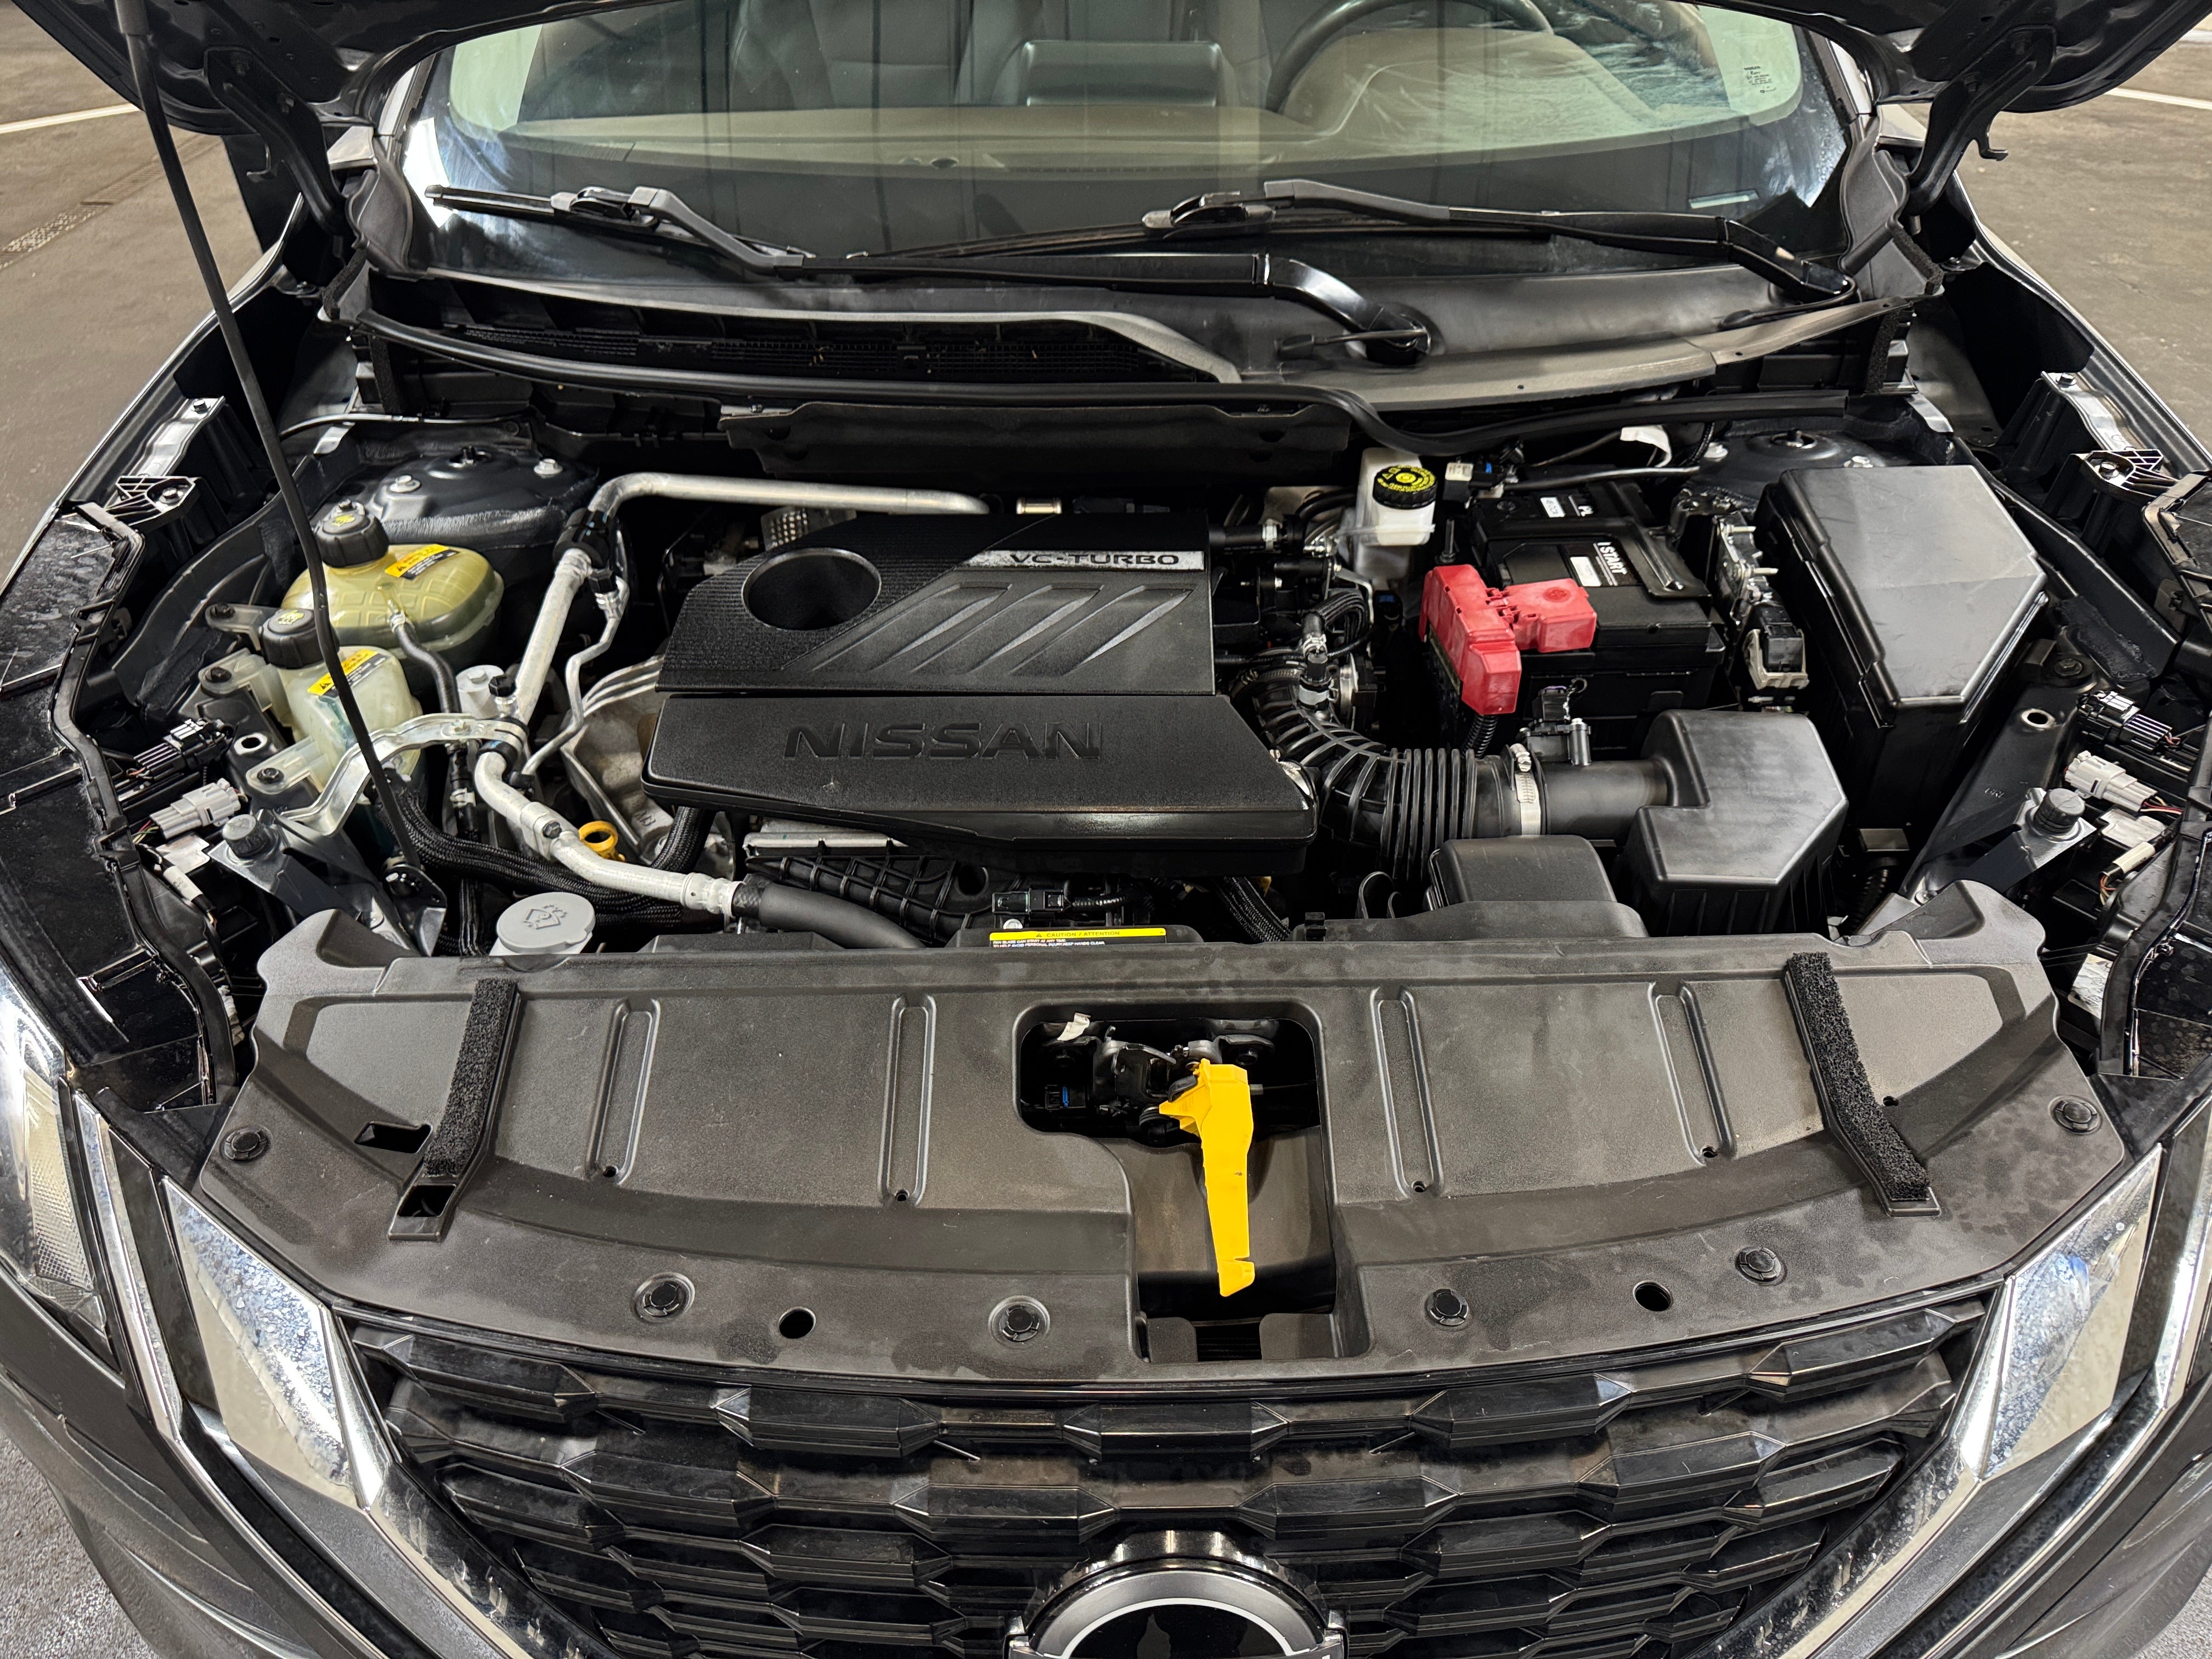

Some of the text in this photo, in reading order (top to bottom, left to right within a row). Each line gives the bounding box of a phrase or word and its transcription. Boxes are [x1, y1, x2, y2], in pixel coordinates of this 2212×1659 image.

[1009, 553, 1180, 565] VC-TURBO
[1600, 546, 1628, 575] START
[782, 721, 1102, 759] NISSAN
